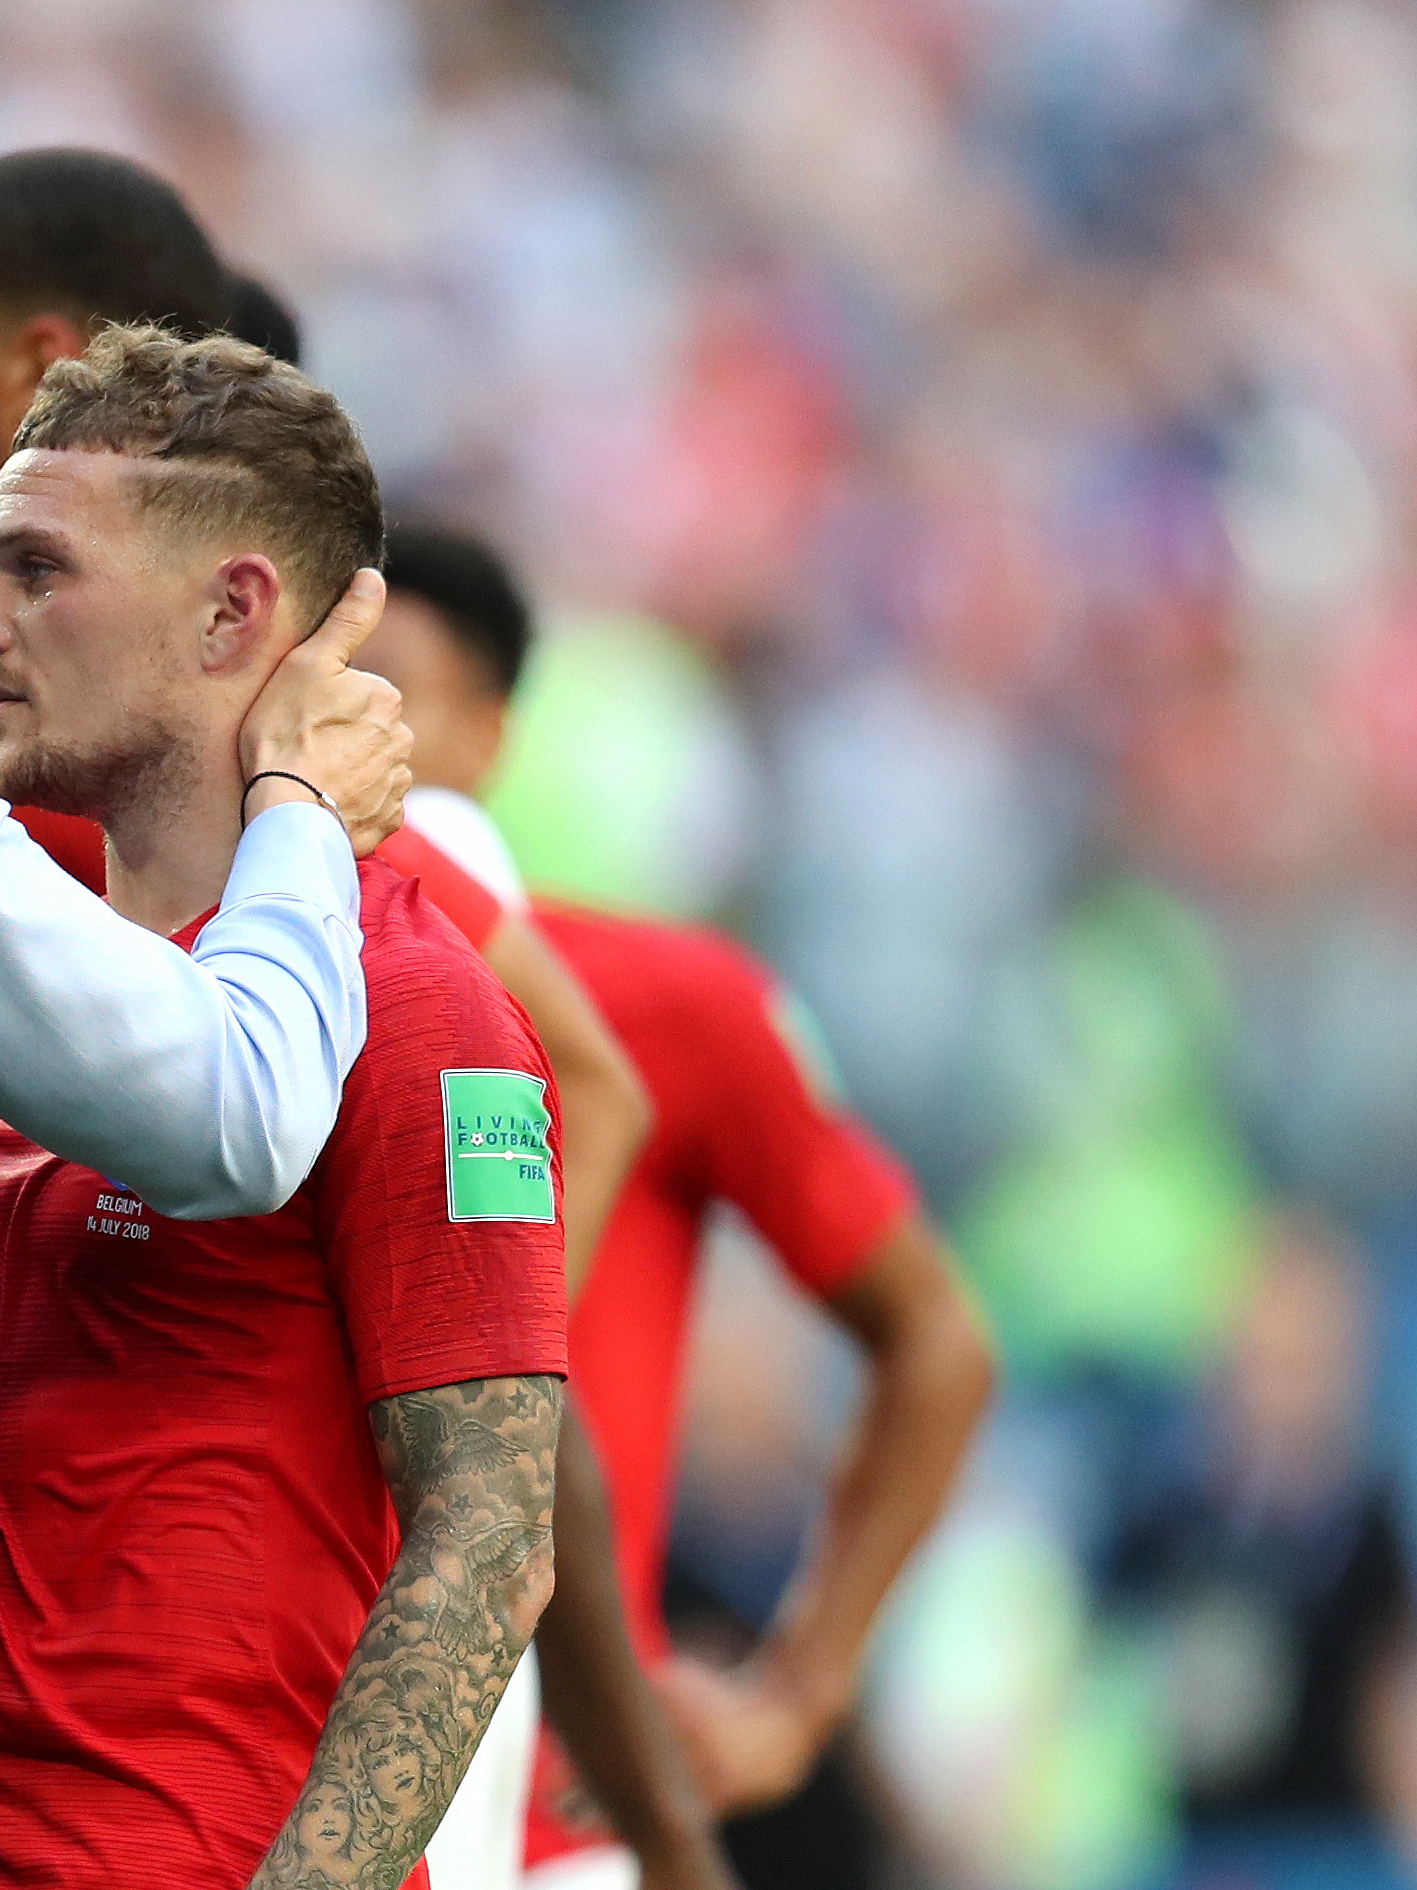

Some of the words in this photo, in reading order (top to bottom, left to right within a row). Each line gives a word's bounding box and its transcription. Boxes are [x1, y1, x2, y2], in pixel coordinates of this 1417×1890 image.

[457, 1116, 543, 1133] LIVING
[519, 1164, 546, 1181] FIFA
[96, 1194, 143, 1216] BELGIUM
[86, 1215, 97, 1232] 14
[98, 1218, 121, 1236] JULY
[122, 1222, 150, 1240] 2018
